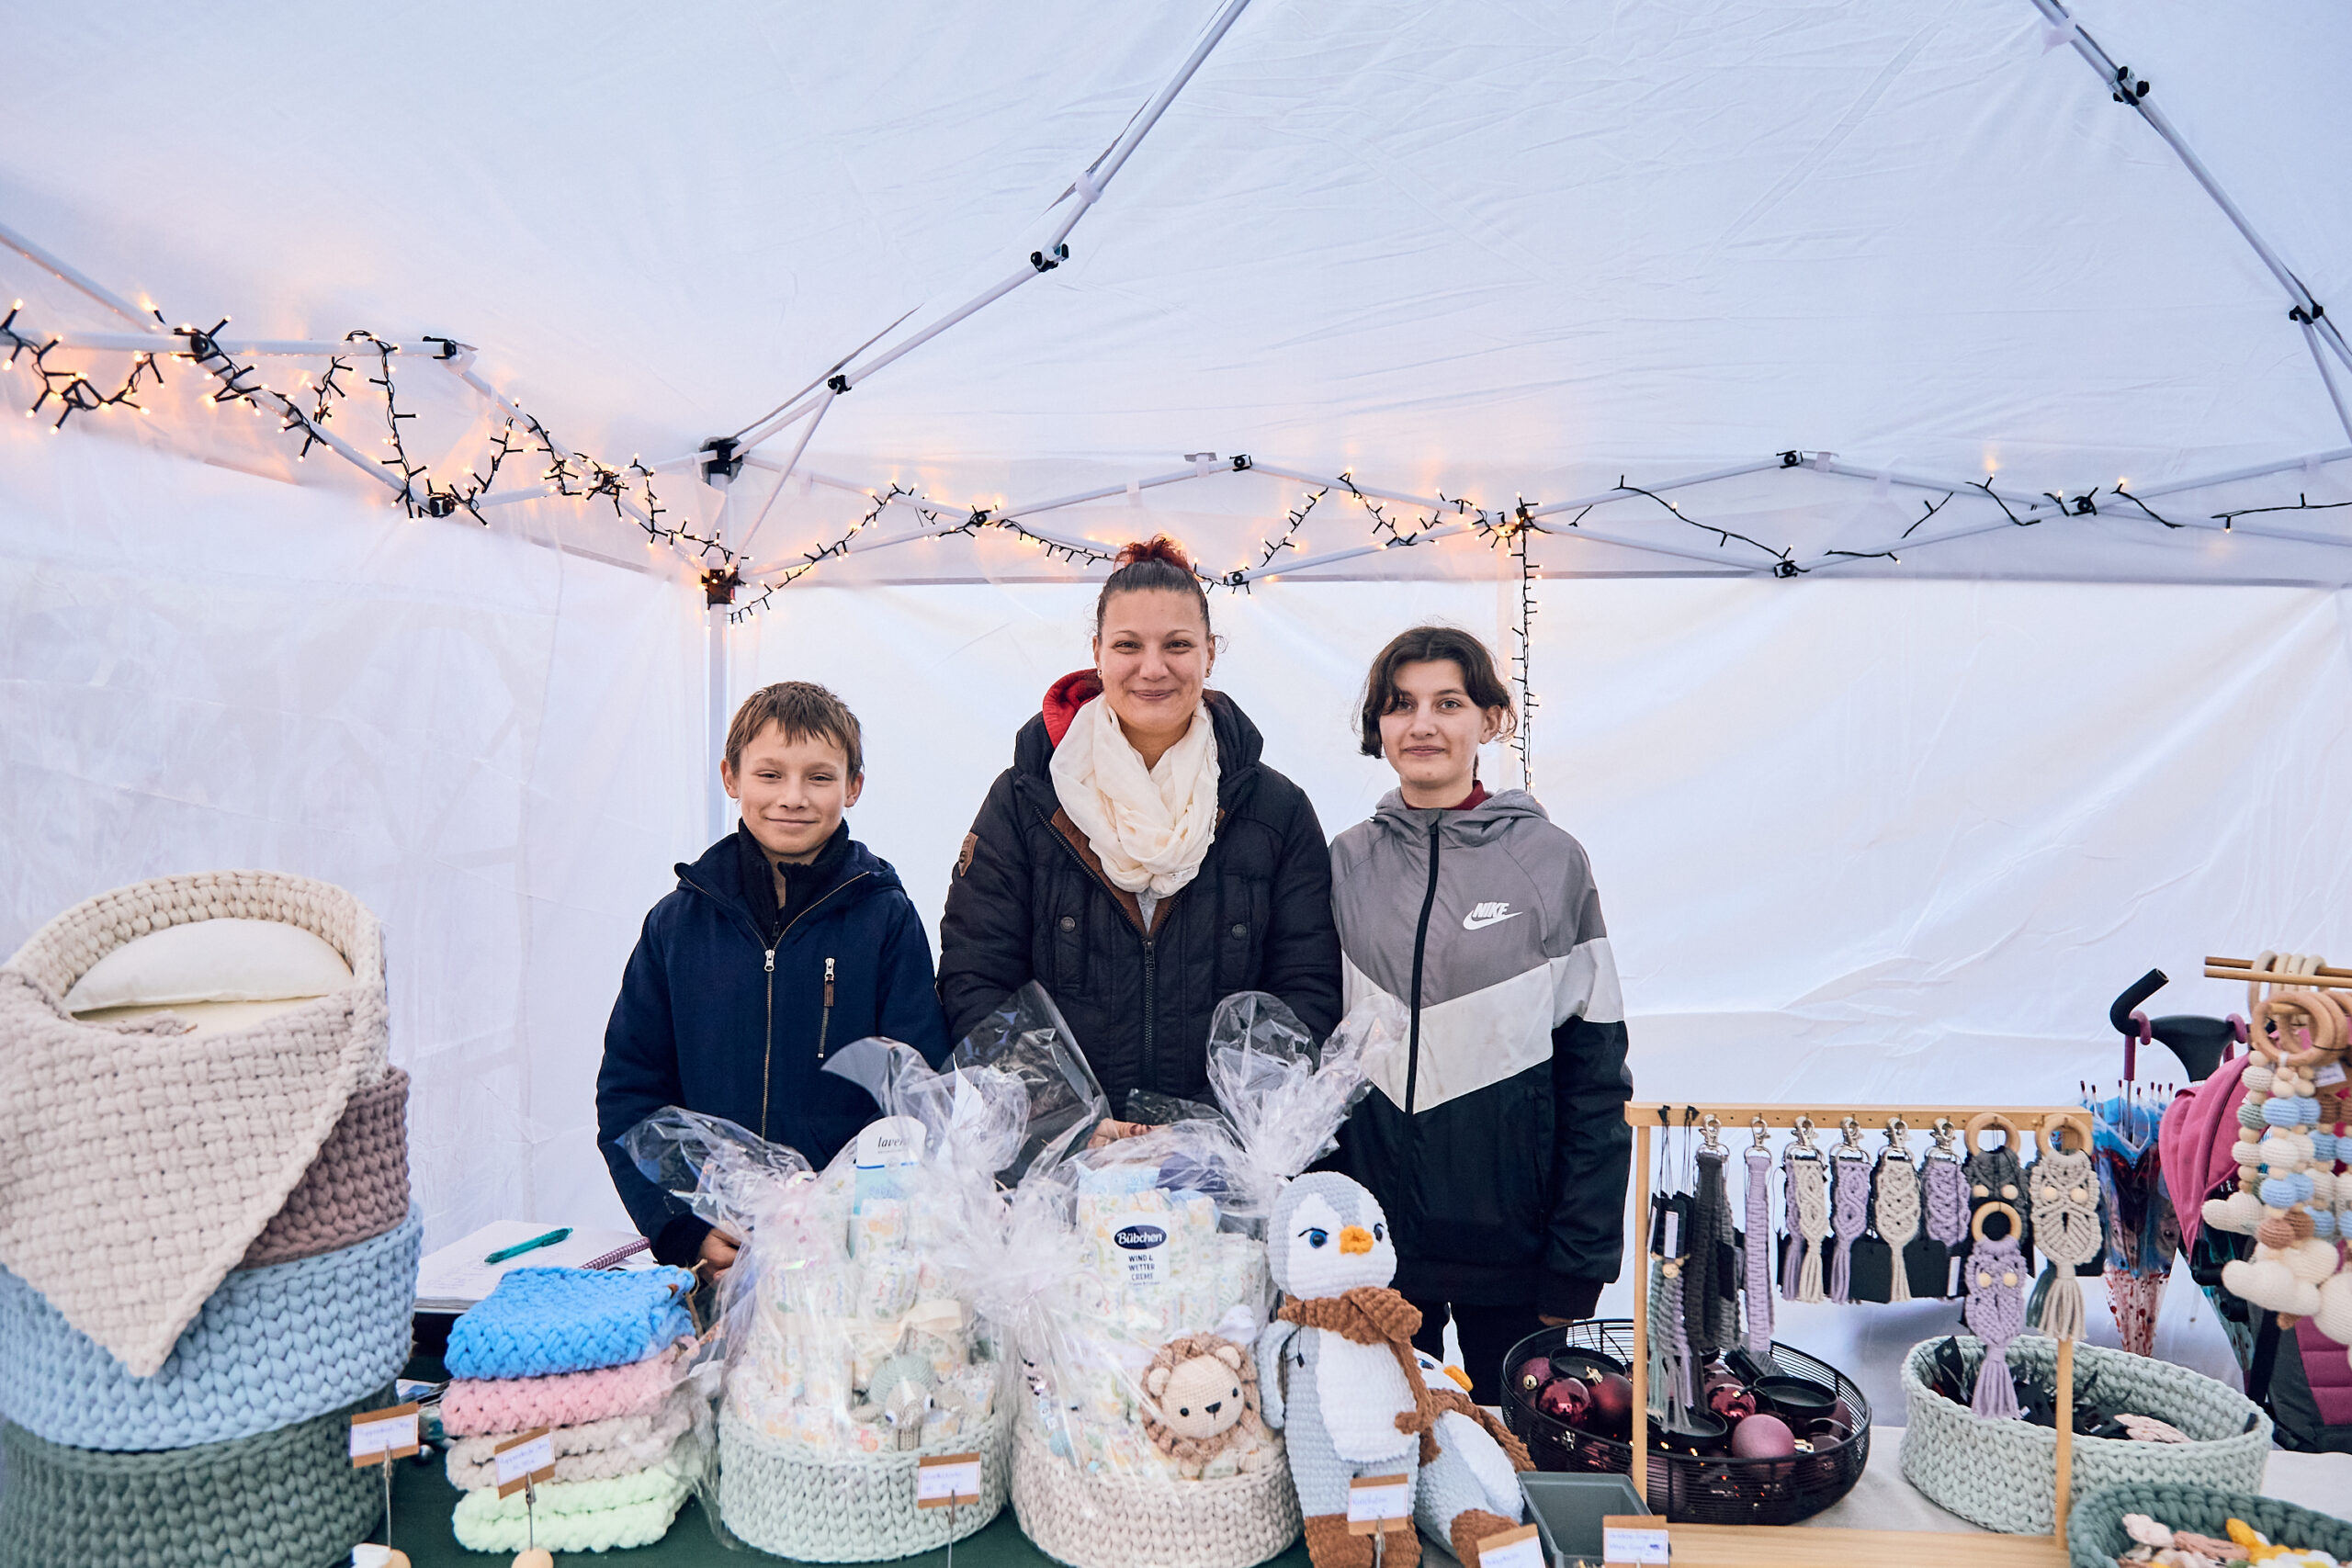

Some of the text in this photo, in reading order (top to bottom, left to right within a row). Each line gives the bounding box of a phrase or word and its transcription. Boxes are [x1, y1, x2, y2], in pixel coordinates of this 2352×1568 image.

[1472, 902, 1510, 918] NIKE
[877, 1136, 908, 1147] laver
[1116, 1231, 1163, 1245] Bübchen
[1128, 1254, 1148, 1262] WIND
[1128, 1263, 1155, 1271] WETTER
